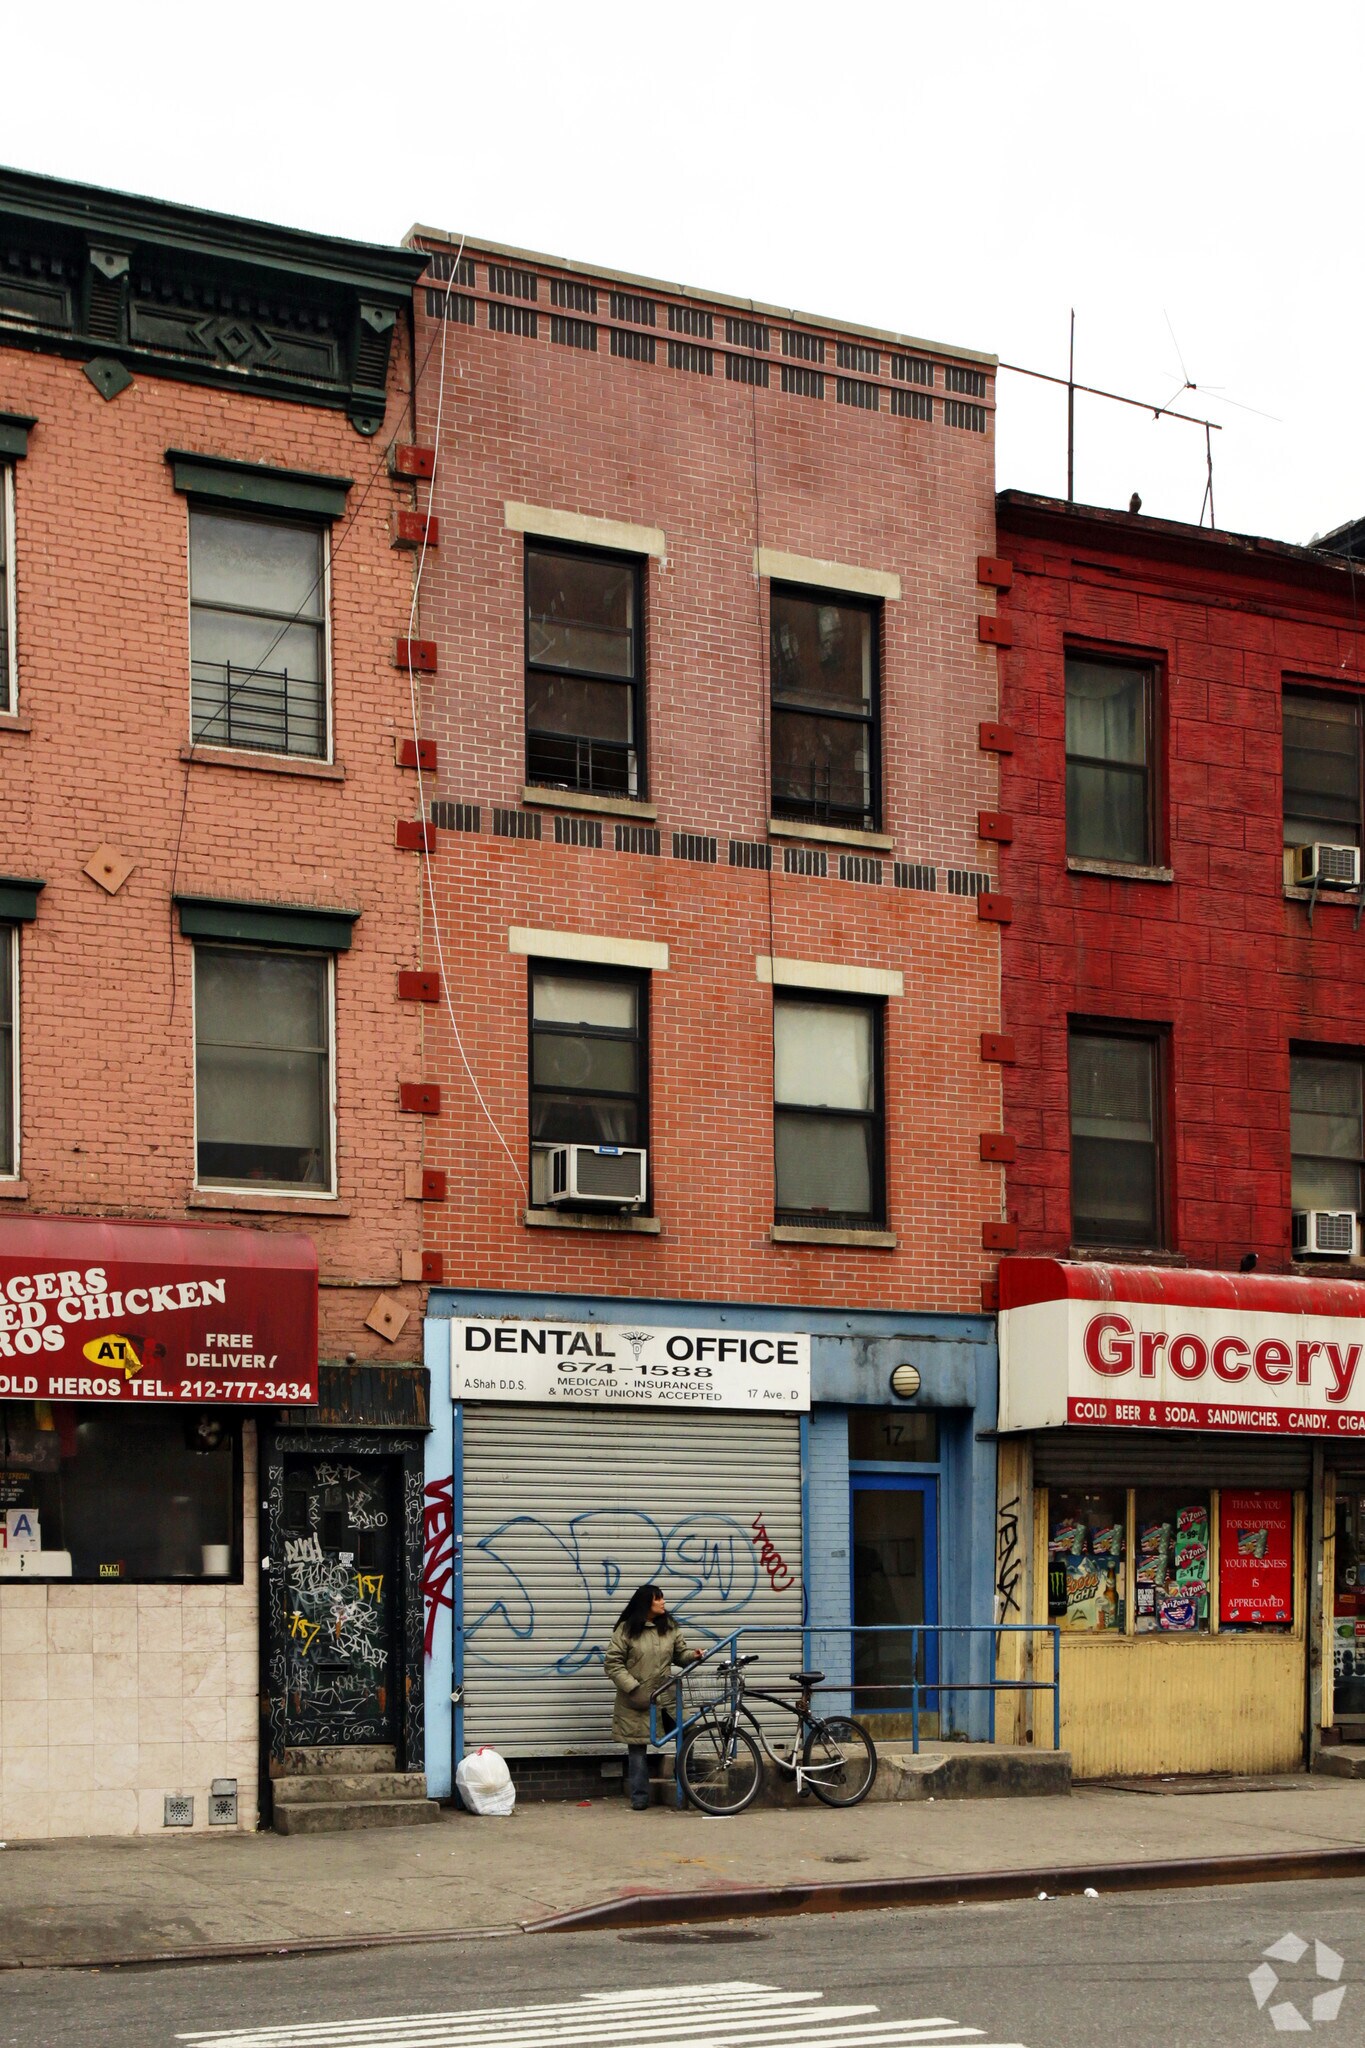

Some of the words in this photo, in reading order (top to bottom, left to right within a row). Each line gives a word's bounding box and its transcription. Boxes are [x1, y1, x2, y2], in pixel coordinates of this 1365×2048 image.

[57, 1278, 226, 1324] CHICKEN
[206, 1333, 253, 1348] FREE
[465, 1326, 616, 1358] DENTAL
[666, 1335, 799, 1365] OFFICE
[1083, 1312, 1363, 1404] Grocery
[557, 1361, 713, 1378] 674-1588
[49, 1377, 121, 1396] HEROS
[129, 1379, 173, 1397] TEL.
[180, 1381, 312, 1400] 212-777-3434
[464, 1378, 496, 1390] A.Shah
[499, 1379, 527, 1390] D.D.S.
[557, 1377, 618, 1387] MEDICAID
[634, 1379, 714, 1391] INSURANCES
[548, 1387, 557, 1396] &
[563, 1387, 600, 1397] MOST
[604, 1388, 653, 1399] UNIONS
[658, 1391, 722, 1401] ACCEPTED
[747, 1389, 758, 1399] 17
[763, 1389, 786, 1400] Ave.
[791, 1390, 799, 1400] D
[1075, 1402, 1107, 1419] COLD
[1116, 1403, 1141, 1421] BEER
[1149, 1405, 1157, 1421] &
[1165, 1406, 1199, 1423] SODA.
[1207, 1409, 1281, 1427] SANDWICHES.
[1288, 1412, 1330, 1430] CANDY.
[882, 1425, 904, 1446] 17
[1232, 1500, 1261, 1509] THANK
[1264, 1501, 1281, 1510] YOU
[13, 1514, 32, 1537] A
[1178, 1508, 1207, 1528] AriZona
[1226, 1519, 1243, 1529] FOR
[1244, 1520, 1286, 1529] SHOPPING
[1175, 1545, 1206, 1567] AriZona
[1225, 1559, 1248, 1568] YOUR
[1250, 1559, 1287, 1568] BUSINESS
[353, 1573, 384, 1602] 187
[1252, 1579, 1259, 1588] IS
[1162, 1599, 1189, 1609] AriZona
[1228, 1599, 1284, 1607] APPRECIATED
